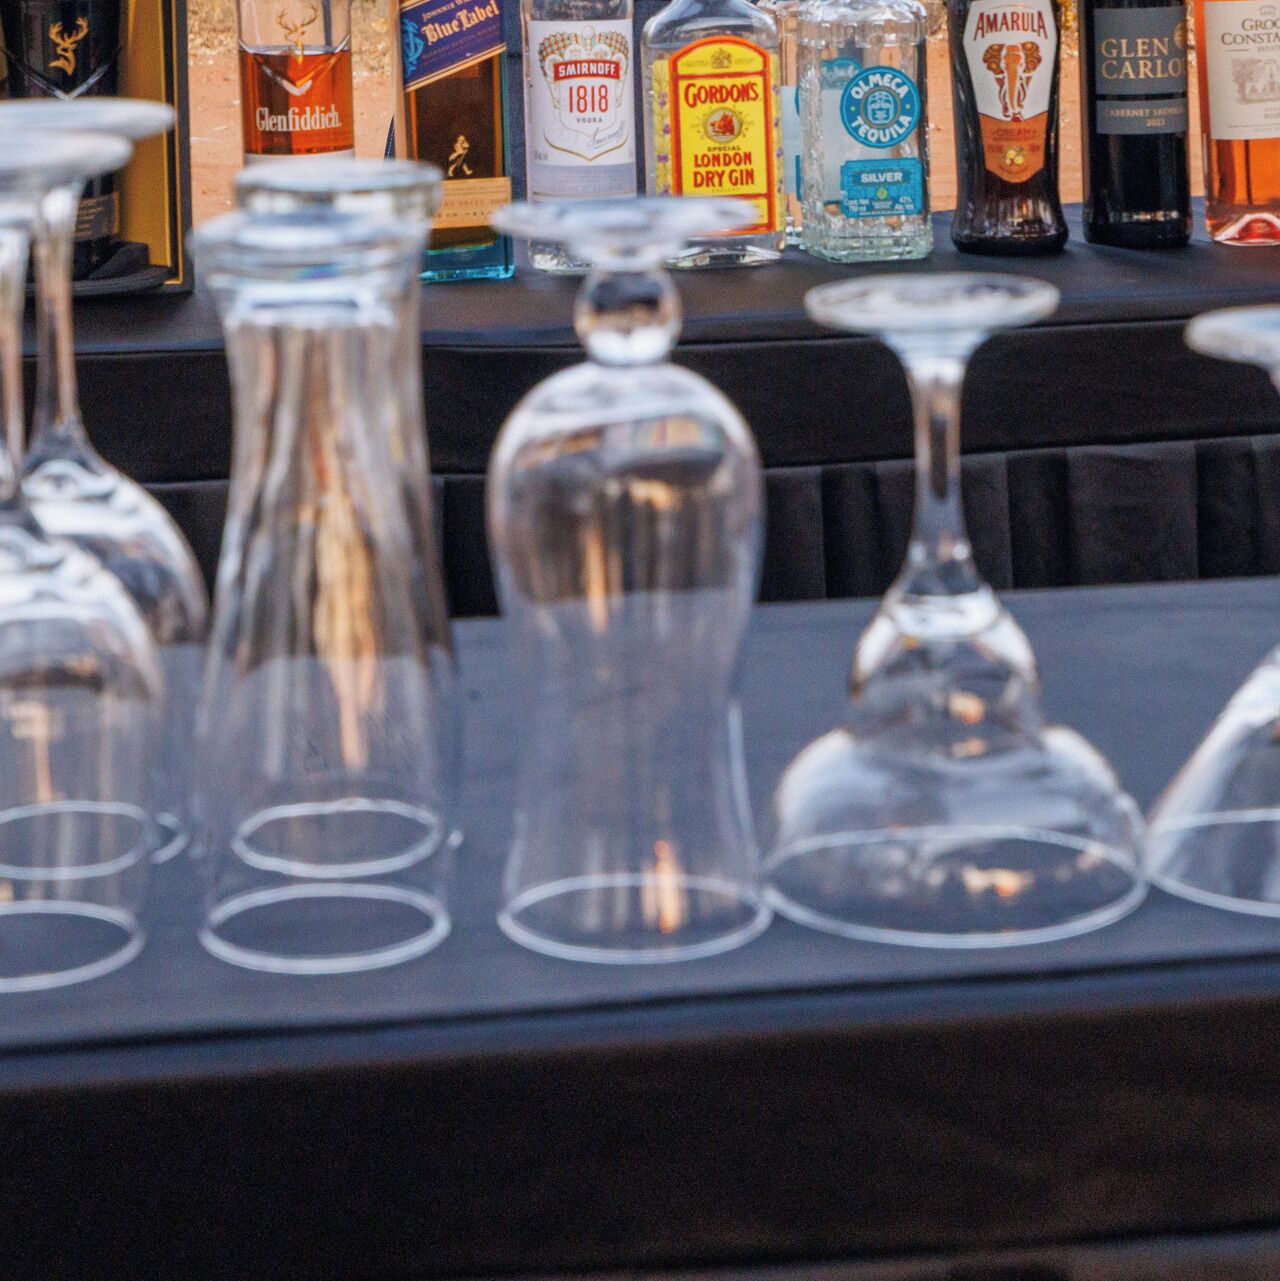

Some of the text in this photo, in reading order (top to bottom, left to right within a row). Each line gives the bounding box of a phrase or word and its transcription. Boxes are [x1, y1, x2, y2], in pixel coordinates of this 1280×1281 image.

[421, 20, 460, 45] Blue
[456, 0, 500, 31] Label
[422, 0, 455, 21] JOHNNIE
[973, 10, 1048, 41] AMARULA
[1101, 37, 1169, 58] GLEN
[559, 62, 615, 77] SMIRNOFF
[568, 84, 608, 113] 1818
[684, 81, 759, 108] GORDON'S
[851, 73, 909, 99] OLMECA
[256, 104, 340, 131] Glenfiddich
[851, 115, 912, 143] TEQUILA
[694, 151, 752, 168] LONDON
[693, 168, 754, 188] DRY GIN
[861, 171, 903, 183] SILVER
